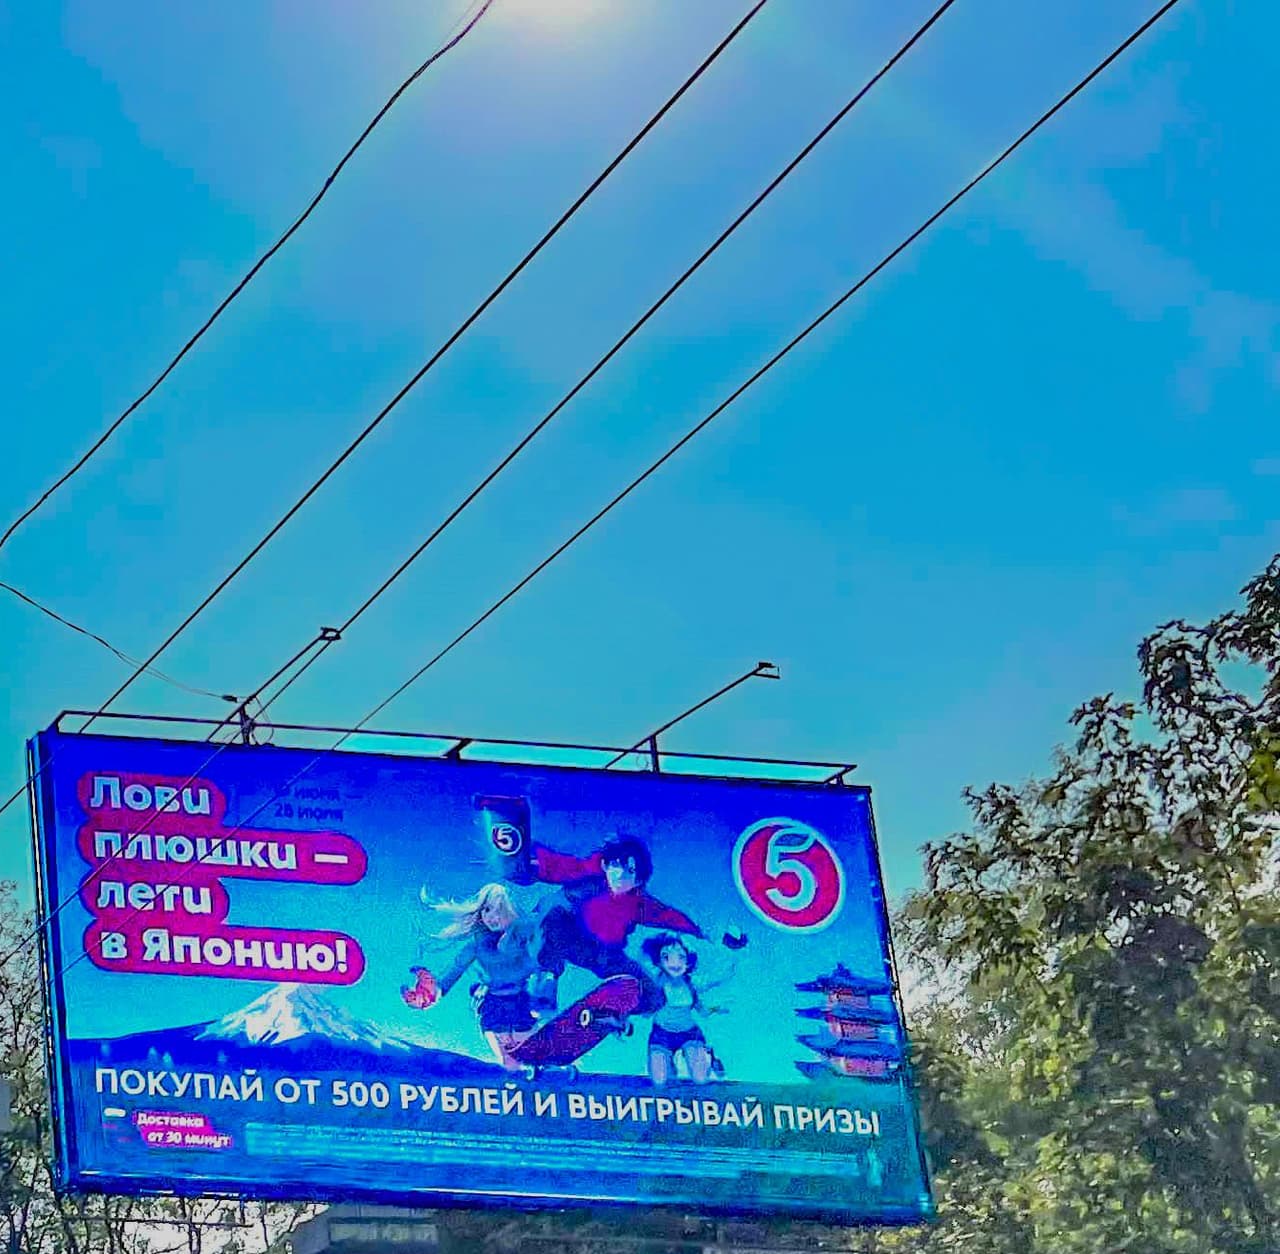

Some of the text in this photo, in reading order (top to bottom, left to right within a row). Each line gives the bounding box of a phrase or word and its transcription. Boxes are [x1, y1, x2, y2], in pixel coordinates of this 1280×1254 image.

[90, 776, 210, 815] Лови
[94, 831, 297, 870] плюшки
[765, 825, 819, 912] 5
[97, 880, 212, 914] лети
[100, 928, 348, 973] в Японию!
[96, 1068, 881, 1136] ПОКУПАЙ ОТ 500 РУБЛЕЙ И ВЫИГРЫВАЙ ПРИЗЫ
[137, 1112, 204, 1128] Доставка
[185, 1133, 230, 1148] минут
